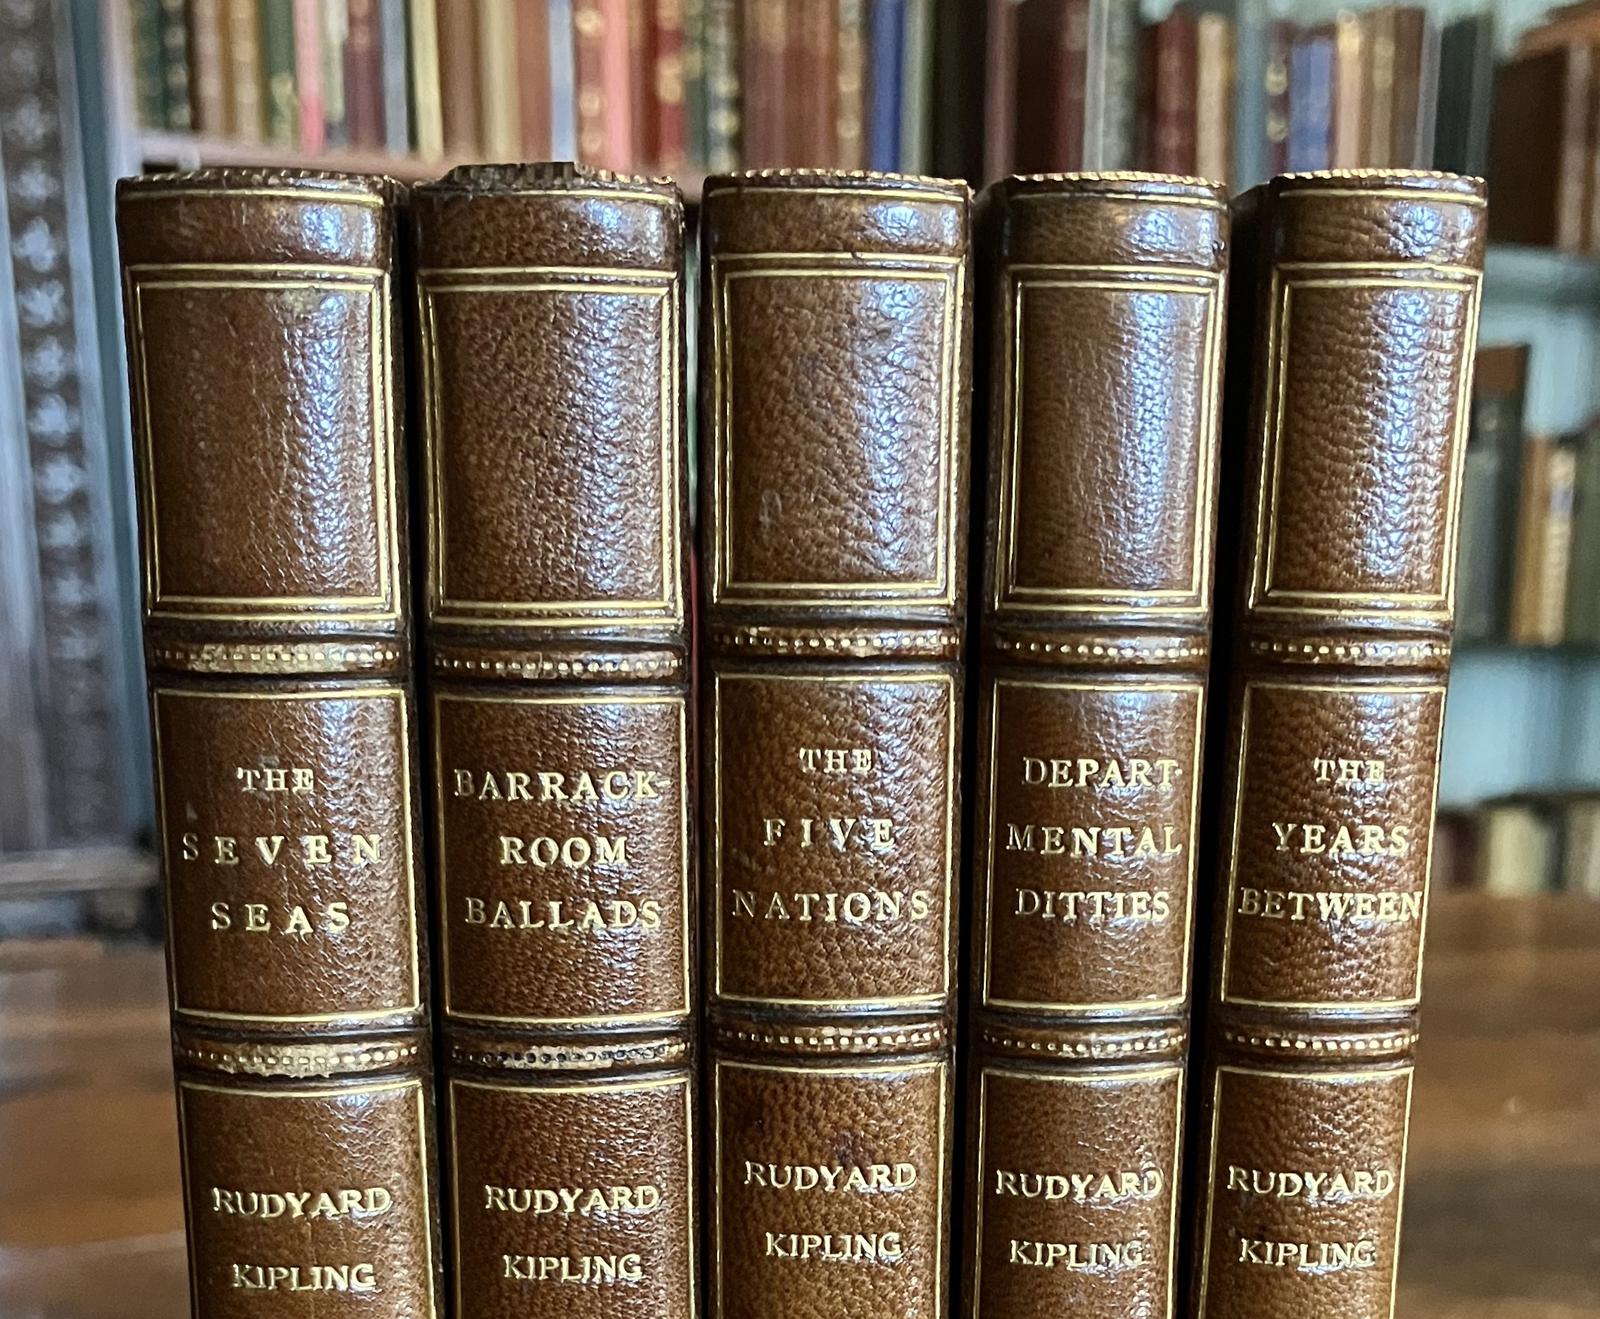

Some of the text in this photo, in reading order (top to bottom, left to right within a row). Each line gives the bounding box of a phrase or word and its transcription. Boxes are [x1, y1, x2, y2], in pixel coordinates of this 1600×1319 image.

[799, 747, 873, 774] THE
[1312, 756, 1385, 784] THE
[236, 766, 314, 793] THE
[182, 833, 383, 866] SEVEN
[500, 836, 629, 866] ROOM
[763, 818, 896, 853] FIVE
[1007, 822, 1182, 856] MENTAL
[1272, 821, 1410, 855] YEARS
[211, 901, 351, 935] SEAS
[465, 897, 661, 930] BALLADS
[732, 889, 930, 922] NATIONS
[1015, 887, 1171, 921] DITTIES
[1237, 887, 1423, 922] BETWEEN
[744, 1161, 917, 1192] RUDYARD
[995, 1168, 1164, 1203] RUDYARD
[1226, 1165, 1396, 1199] RUDYARD
[212, 1187, 393, 1218] RUDYARD
[484, 1184, 661, 1214] RUDYARD
[765, 1231, 903, 1263] KIPLING
[1008, 1238, 1145, 1272] KIPLING
[1238, 1238, 1376, 1269] KIPLING
[232, 1263, 377, 1291] KIPLING
[503, 1253, 643, 1283] KIPLING
